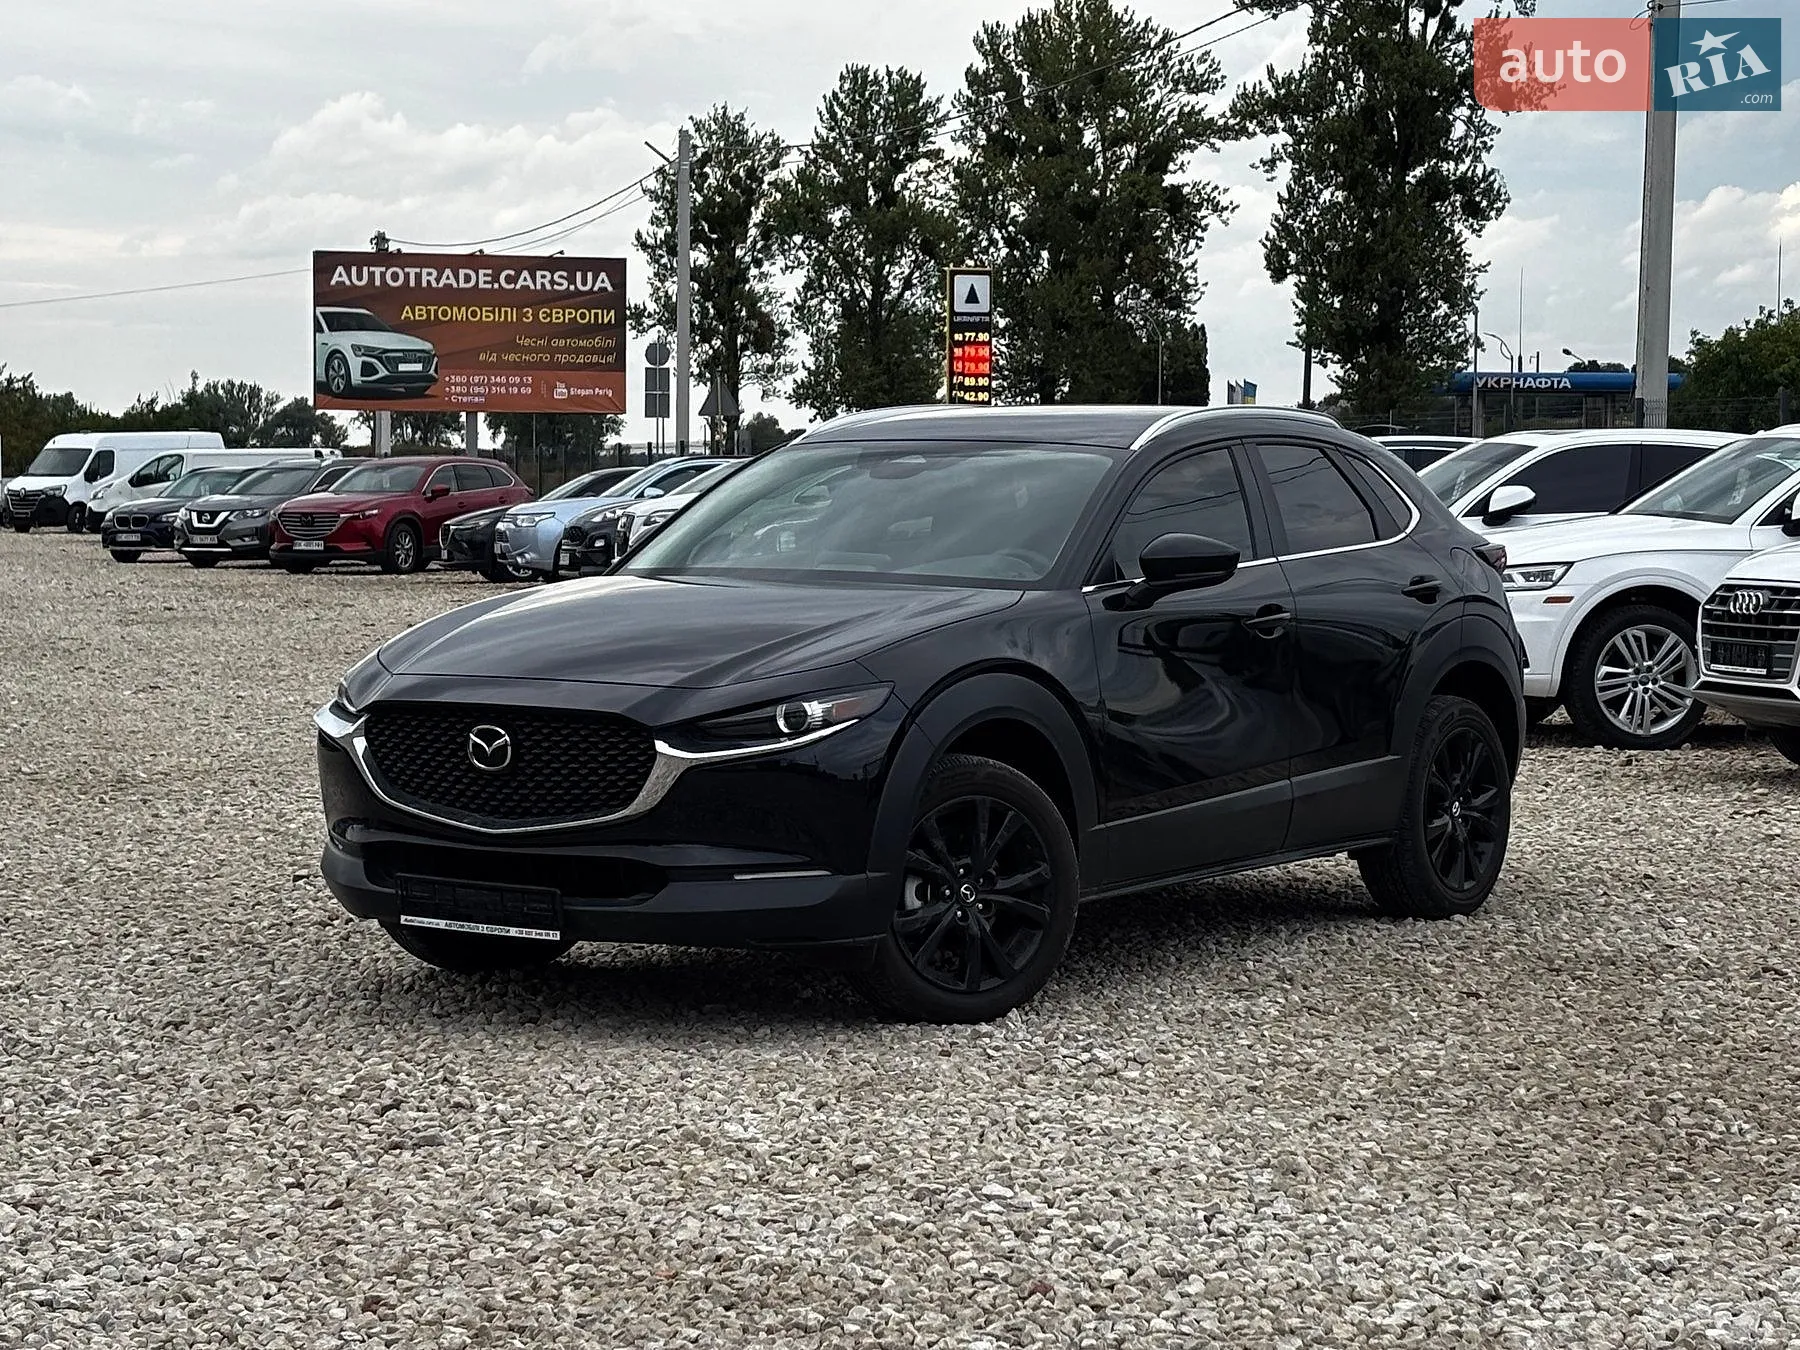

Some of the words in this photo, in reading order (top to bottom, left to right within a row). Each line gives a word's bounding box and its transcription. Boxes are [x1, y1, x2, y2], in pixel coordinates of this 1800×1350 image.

[330, 265, 613, 292] AUTOTRADE.CARS.UA
[401, 305, 516, 323] АВТОМОБІЛІ
[522, 307, 533, 323] З
[538, 308, 615, 324] ЄВРОПИ
[516, 335, 548, 347] Чесні
[550, 336, 616, 348] автомобілі
[501, 352, 551, 362] чесного
[1475, 376, 1572, 389] УКРНАФТА
